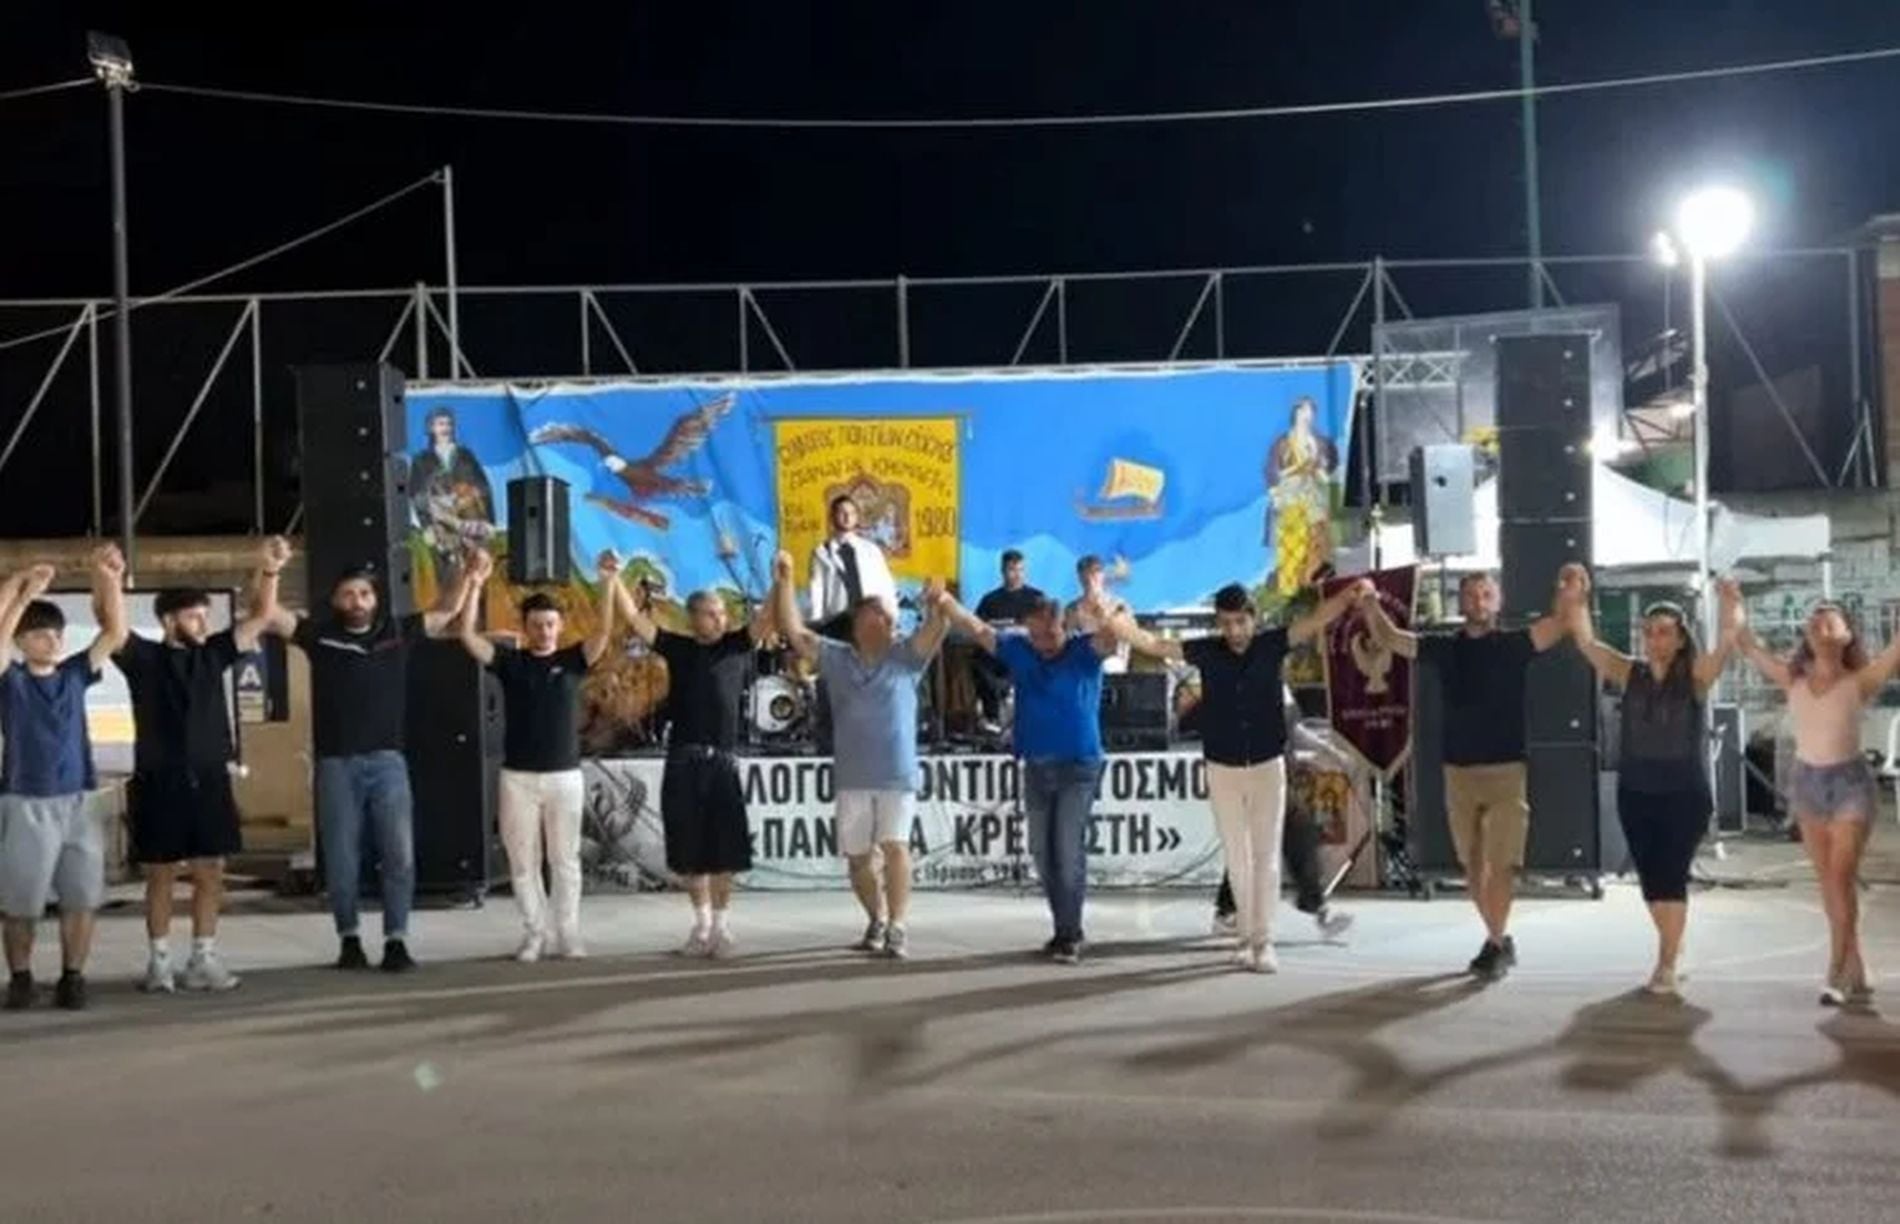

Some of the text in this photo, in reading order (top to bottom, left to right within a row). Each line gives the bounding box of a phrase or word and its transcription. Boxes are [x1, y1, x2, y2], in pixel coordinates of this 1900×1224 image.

[745, 763, 835, 804] ΛΟΓΟ
[916, 760, 1018, 801] ΟΝΤΙΩ
[955, 814, 1181, 855] ΚΡΕΣΤΗ»
